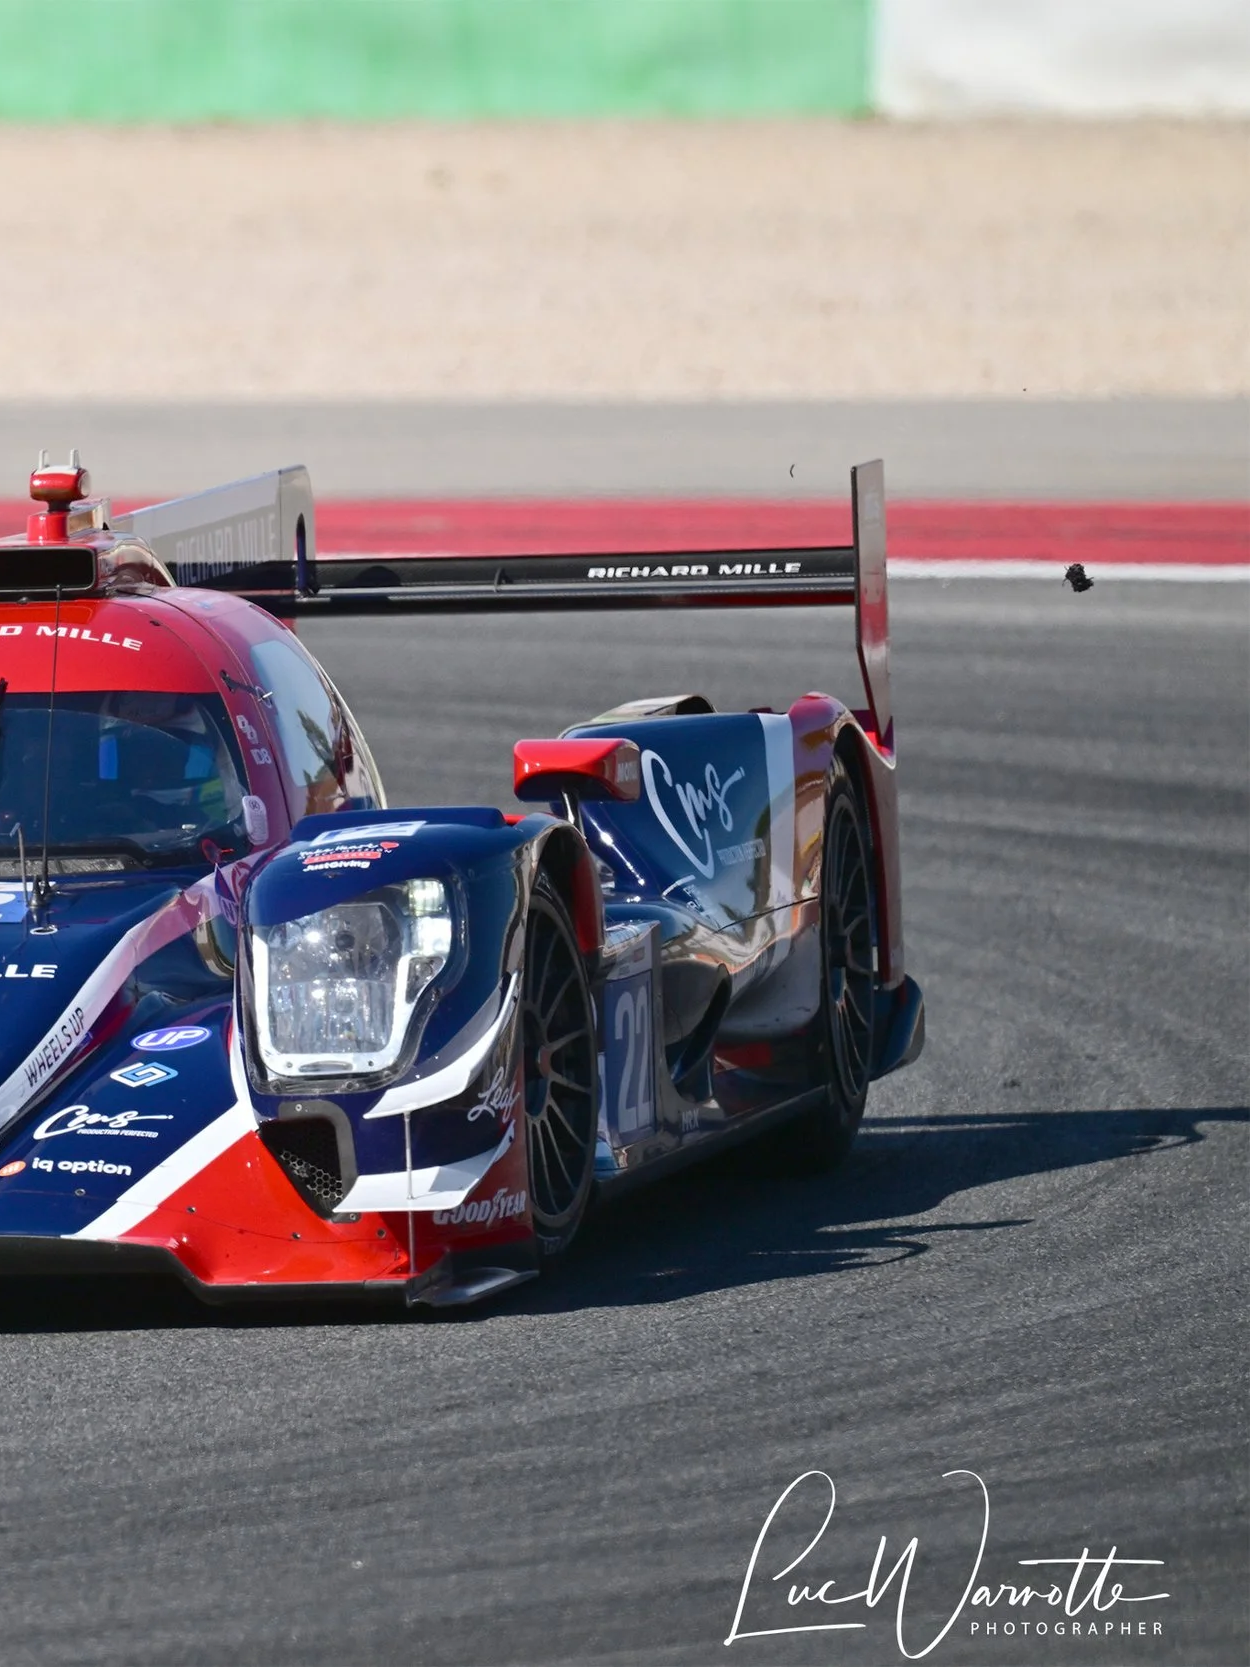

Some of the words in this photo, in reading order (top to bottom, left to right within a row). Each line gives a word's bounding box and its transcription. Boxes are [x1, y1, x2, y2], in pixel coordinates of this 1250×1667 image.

[587, 564, 710, 578] RICHARD
[718, 562, 802, 576] MILLE
[35, 624, 144, 652] MILLE
[23, 1024, 73, 1088] WHEELS
[68, 1006, 86, 1037] UP
[138, 1029, 205, 1048] UP
[467, 1066, 521, 1124] Leaf
[76, 1127, 119, 1136] PRODUCTION
[32, 1157, 54, 1173] iq
[57, 1159, 133, 1176] option
[432, 1187, 526, 1230] GOODYEAR
